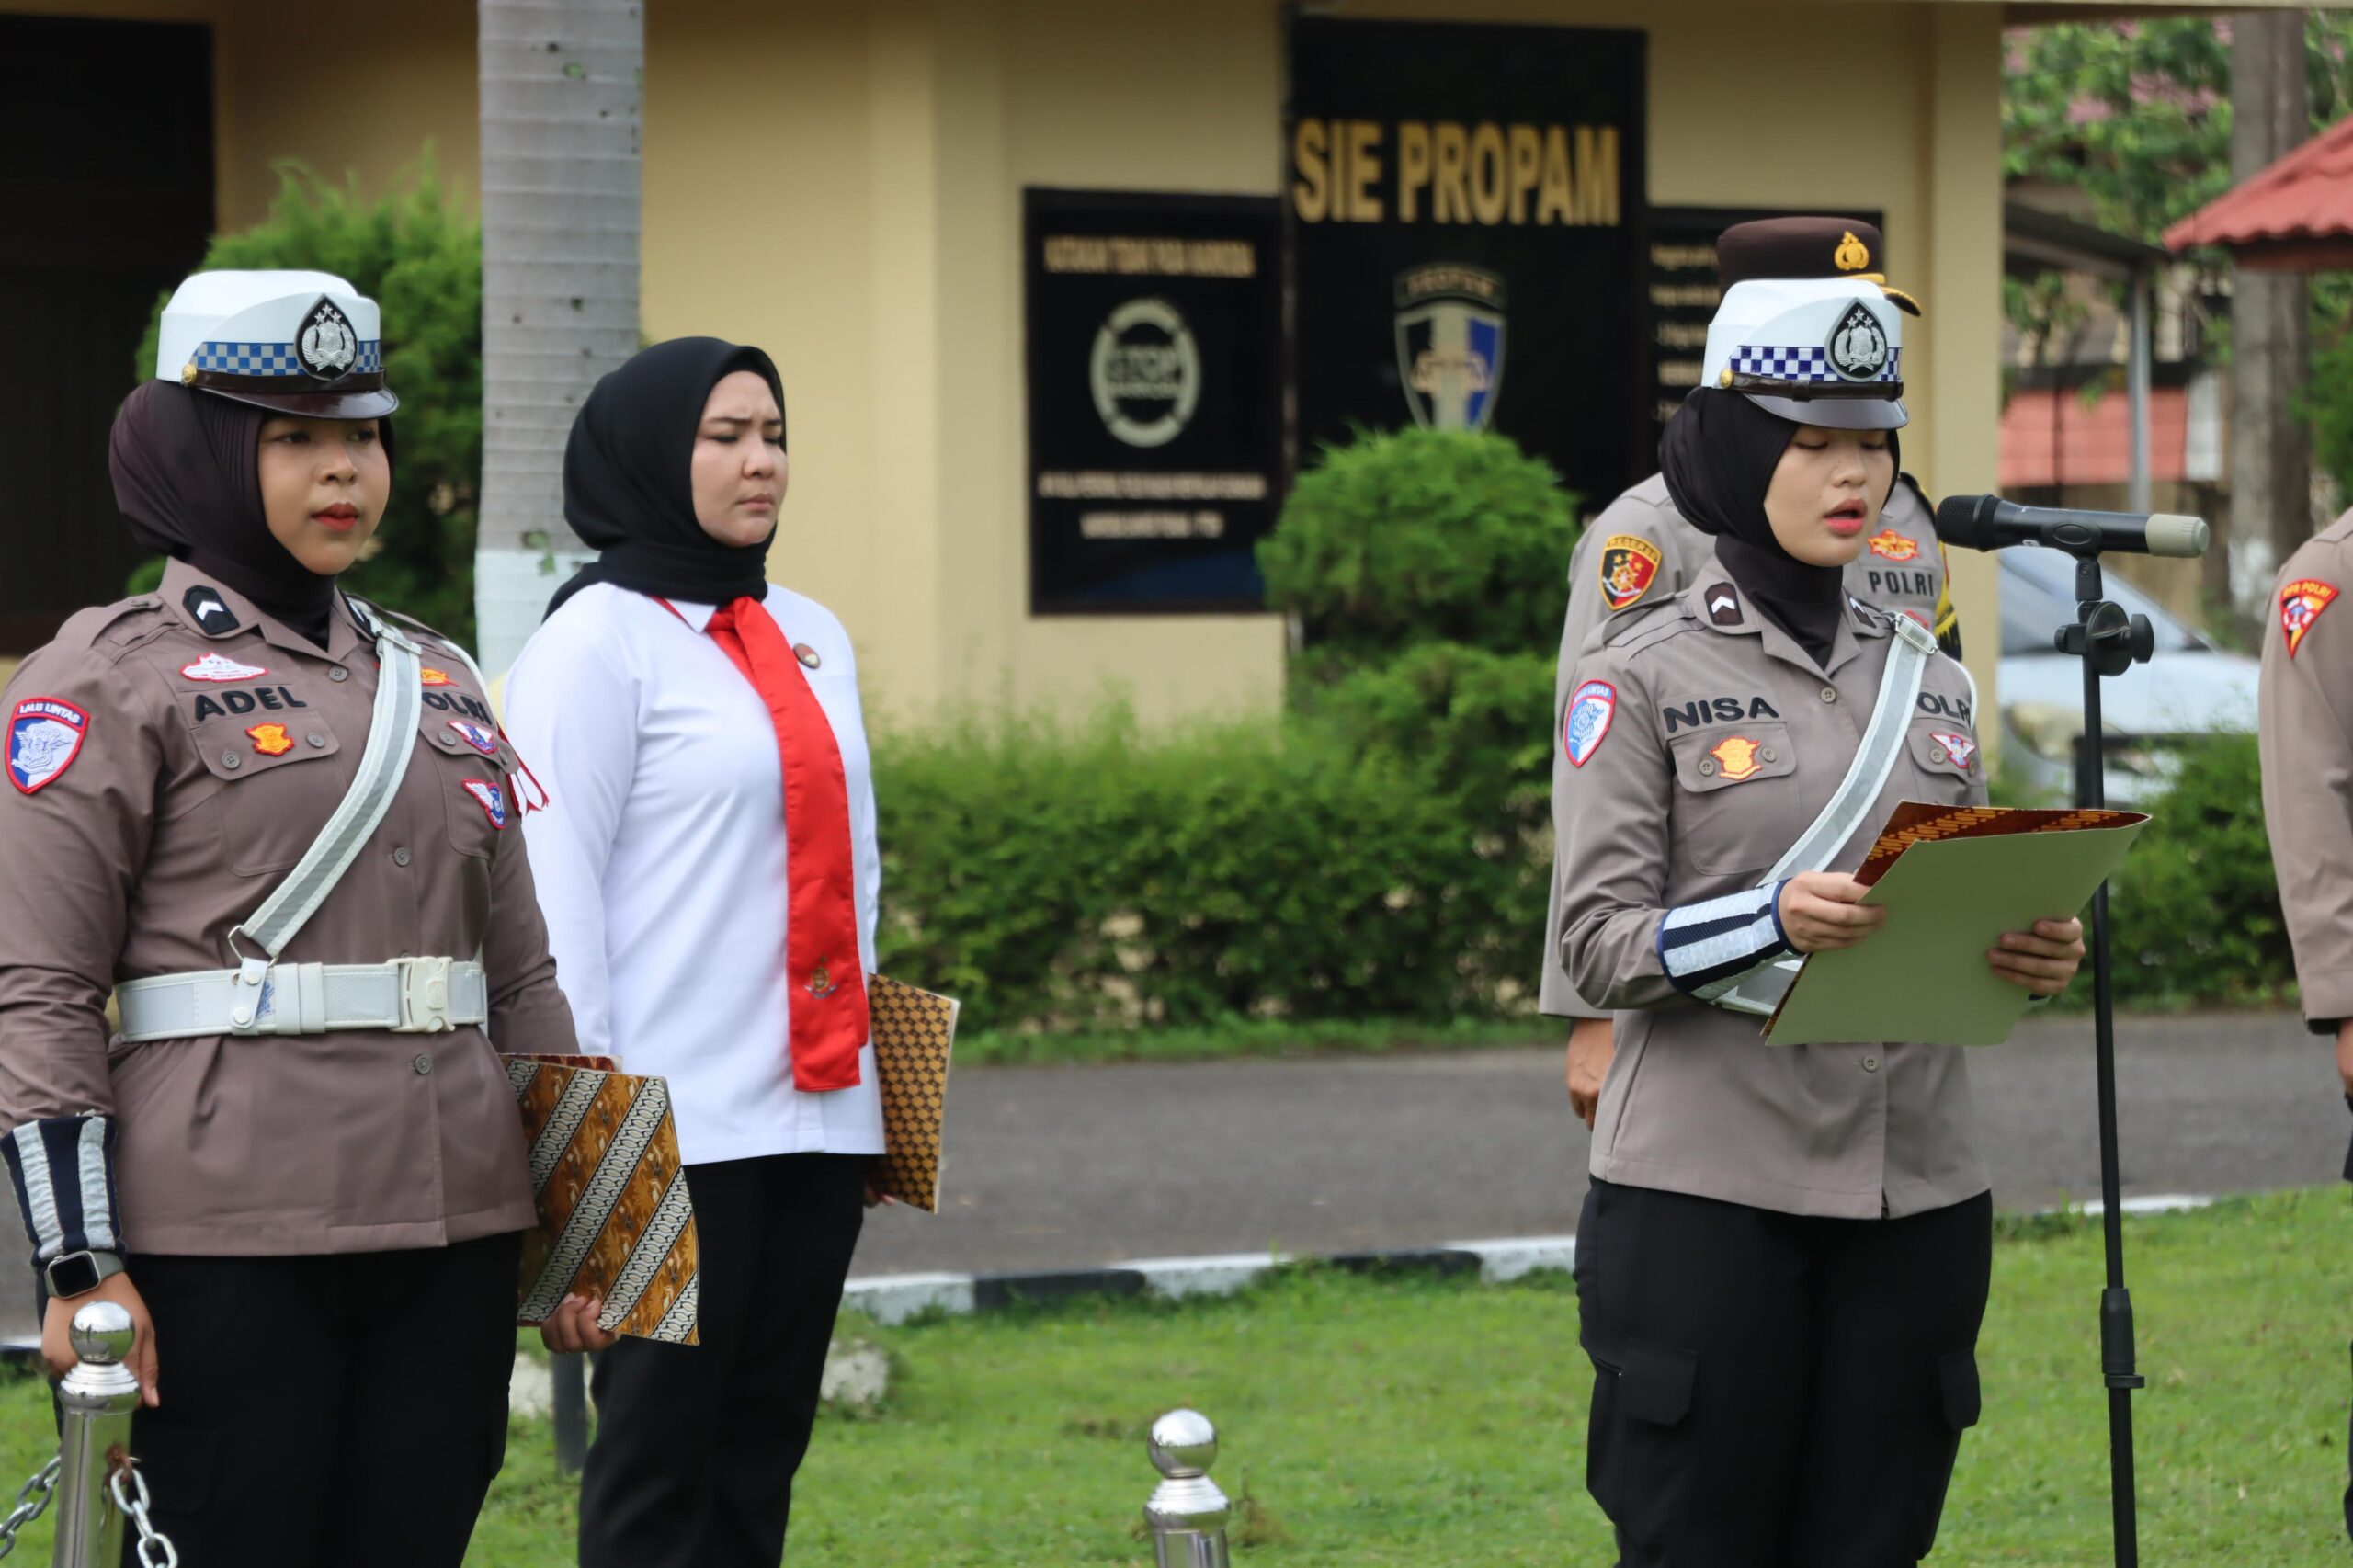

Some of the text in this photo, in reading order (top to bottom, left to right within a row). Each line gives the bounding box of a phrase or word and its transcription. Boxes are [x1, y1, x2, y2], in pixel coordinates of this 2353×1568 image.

[1292, 119, 1620, 225] SIE PROPAM
[1868, 571, 1934, 597] POLRI
[19, 702, 81, 723] LALU LINTAS
[195, 686, 307, 722] ADEL
[421, 692, 493, 725] OLRI
[1663, 696, 1780, 733] NISA
